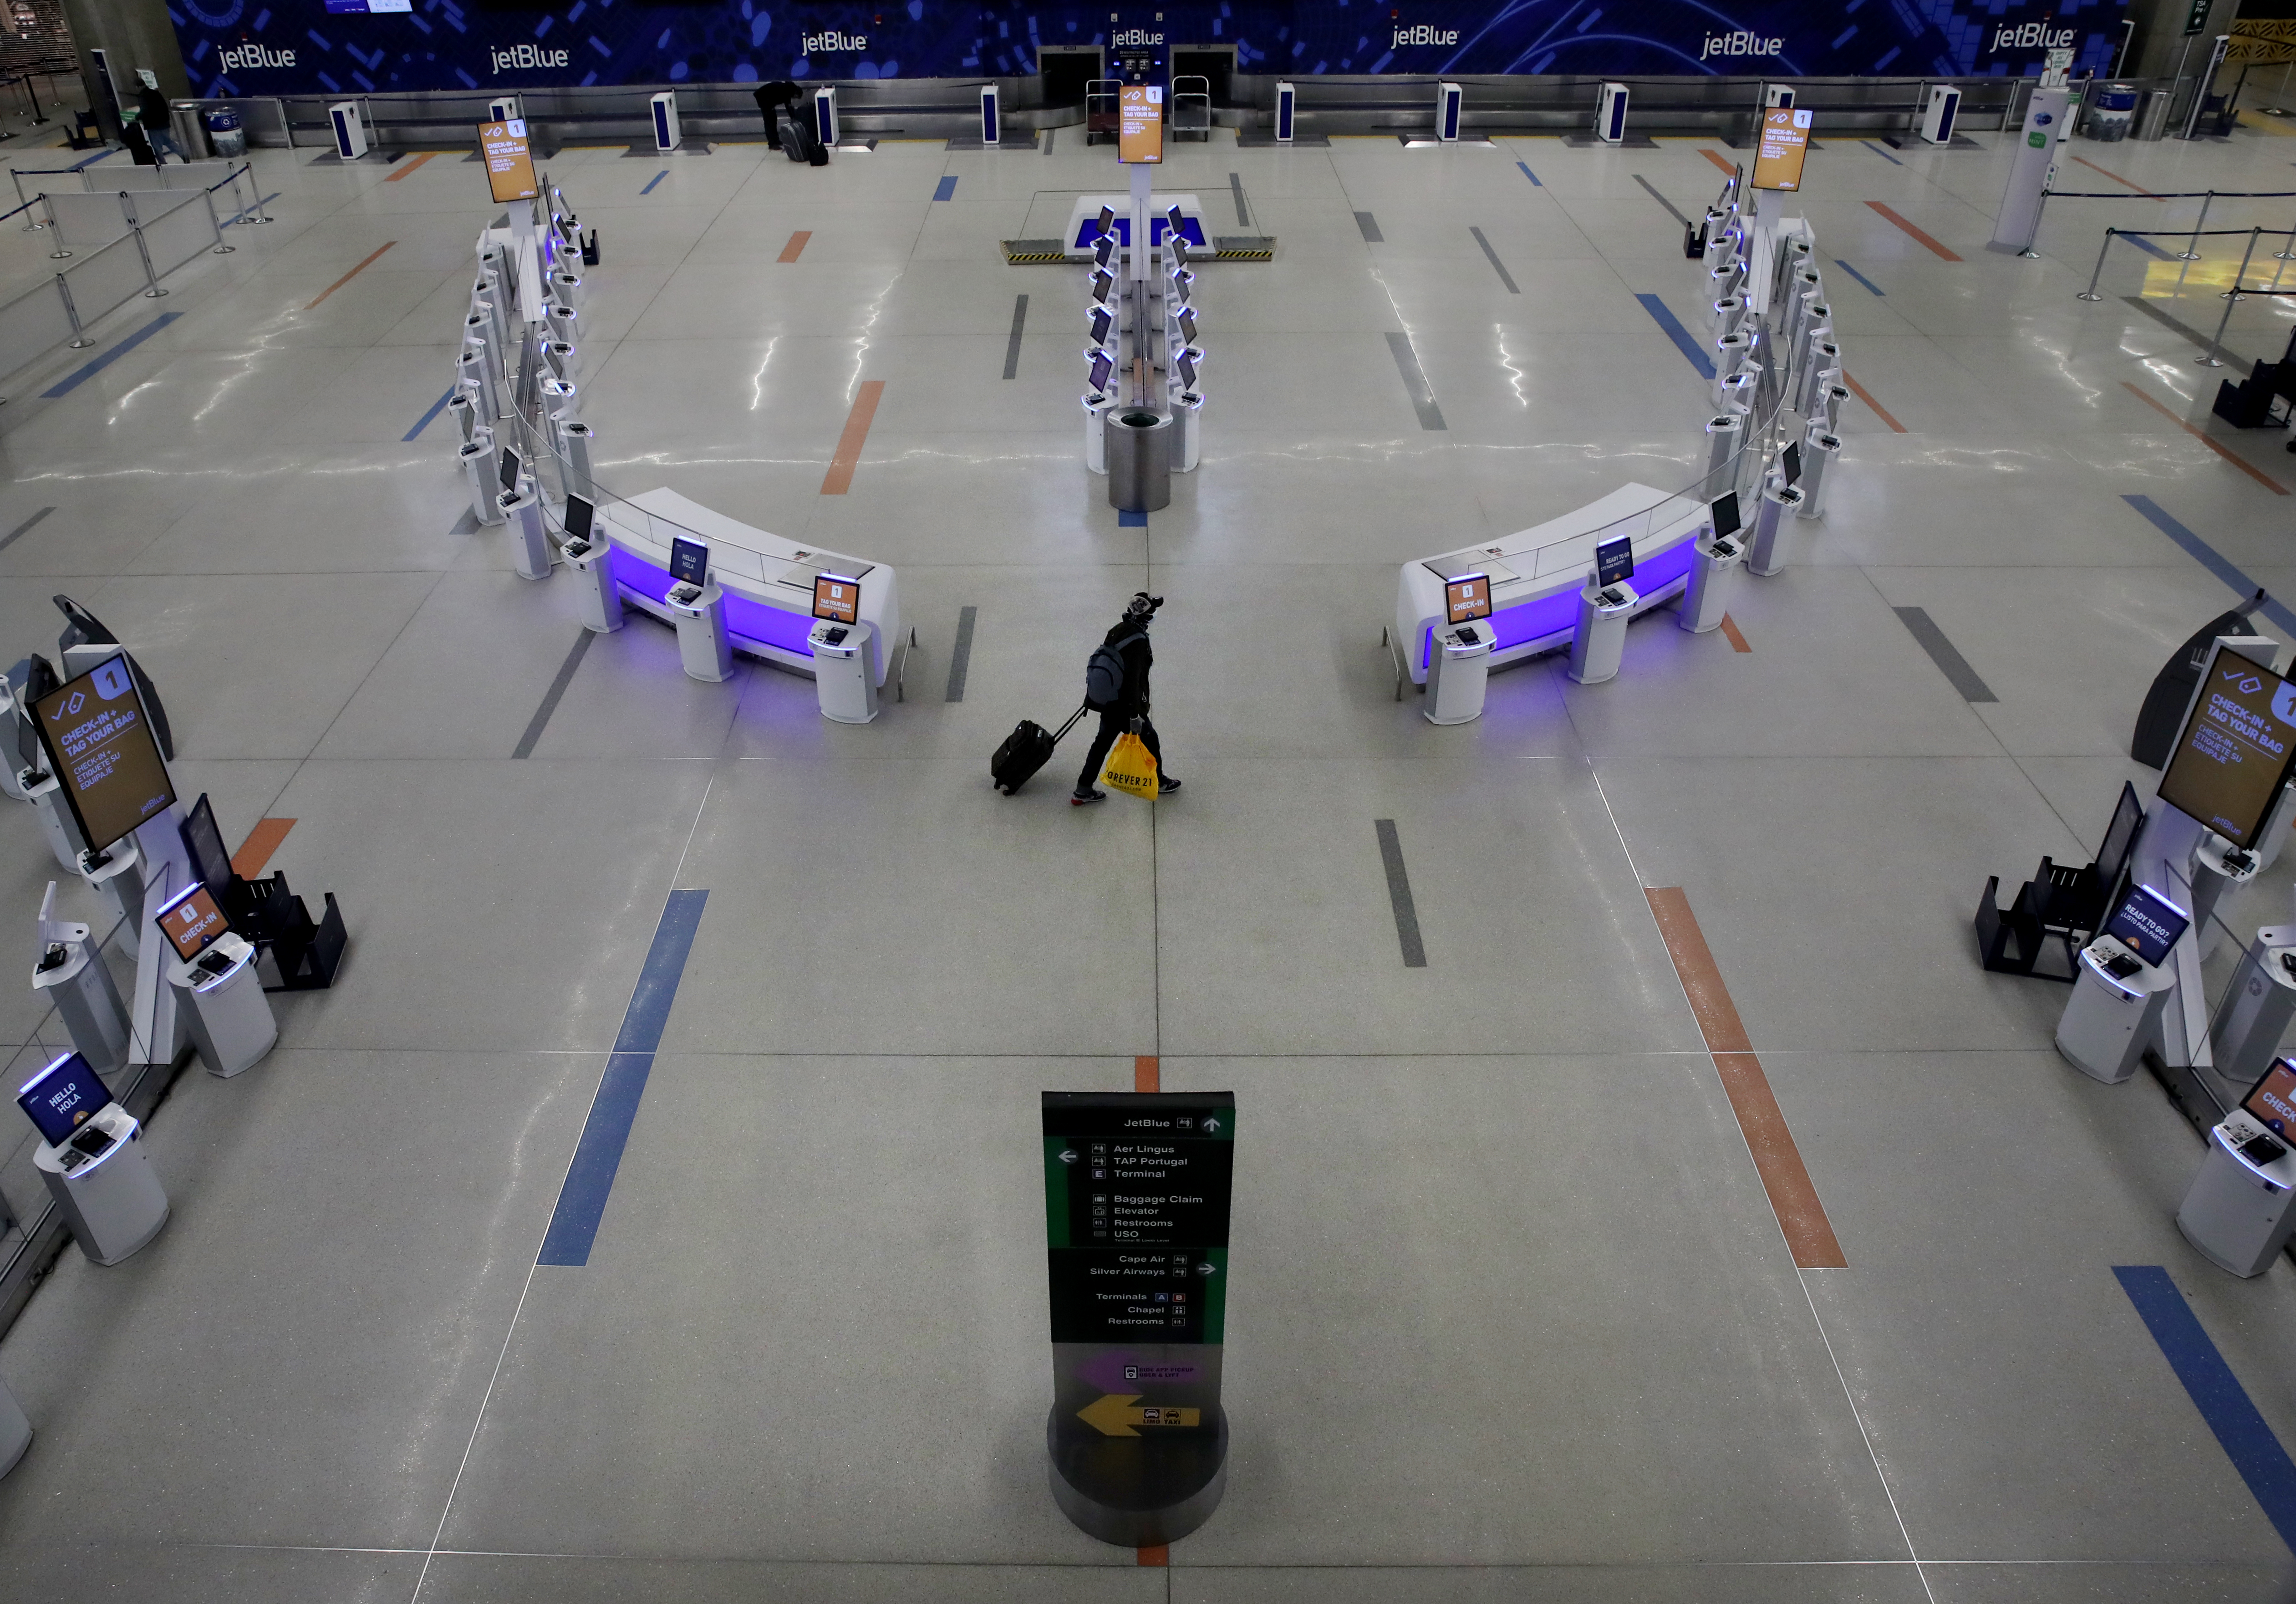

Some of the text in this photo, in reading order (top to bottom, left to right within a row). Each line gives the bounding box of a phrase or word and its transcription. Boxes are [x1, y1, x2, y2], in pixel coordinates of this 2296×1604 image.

[802, 31, 867, 56] jetBlue
[1111, 29, 1164, 49] jetBlue
[1391, 26, 1459, 50] jetBlue
[1700, 31, 1783, 61] jetBlue
[1989, 23, 2075, 53] jetBlue
[218, 45, 295, 74] jetBlue
[490, 44, 569, 74] jetBlue
[1152, 91, 1156, 99] 1
[514, 124, 519, 133] 1
[1800, 115, 1805, 124] 1
[487, 141, 513, 149] CHECK-IN
[682, 553, 696, 563] HELLO
[682, 561, 694, 569] HOLA
[1606, 555, 1619, 564] READY
[1454, 599, 1484, 611] CHECK-IN
[106, 670, 118, 690] 1
[2211, 694, 2265, 729] CHECK-IN
[2288, 697, 2296, 717] 1
[61, 711, 110, 746] CHECK-IN
[65, 710, 136, 757] TAG YOUR BAG
[2199, 724, 2233, 748] CHECK-IN
[2207, 704, 2284, 754] TAG YOUR BAG
[2192, 739, 2227, 764] EQUIPAJE
[2195, 732, 2242, 763] ETIQUETE SU
[74, 752, 107, 775] CHECK-IN
[76, 751, 121, 783] ETIQUETE SU
[80, 766, 114, 791] EQUIPAJE
[1106, 770, 1152, 787] OREVER 21
[140, 793, 166, 815] jetBlue
[2211, 814, 2242, 835] jetBlue
[185, 908, 193, 918] 1
[2125, 904, 2169, 938] READY TO GO?
[180, 912, 218, 944] CHECK-IN
[2120, 912, 2168, 946] ¿LISTO PARA PARTIR?
[49, 1083, 76, 1107] HELLO
[57, 1093, 81, 1114] HOLA
[1124, 1119, 1170, 1127] JetBlue
[1137, 1145, 1175, 1154] Lingus
[1140, 1158, 1187, 1167] Portugal
[1114, 1195, 1166, 1205] Baggage
[1119, 1256, 1147, 1264] Cape
